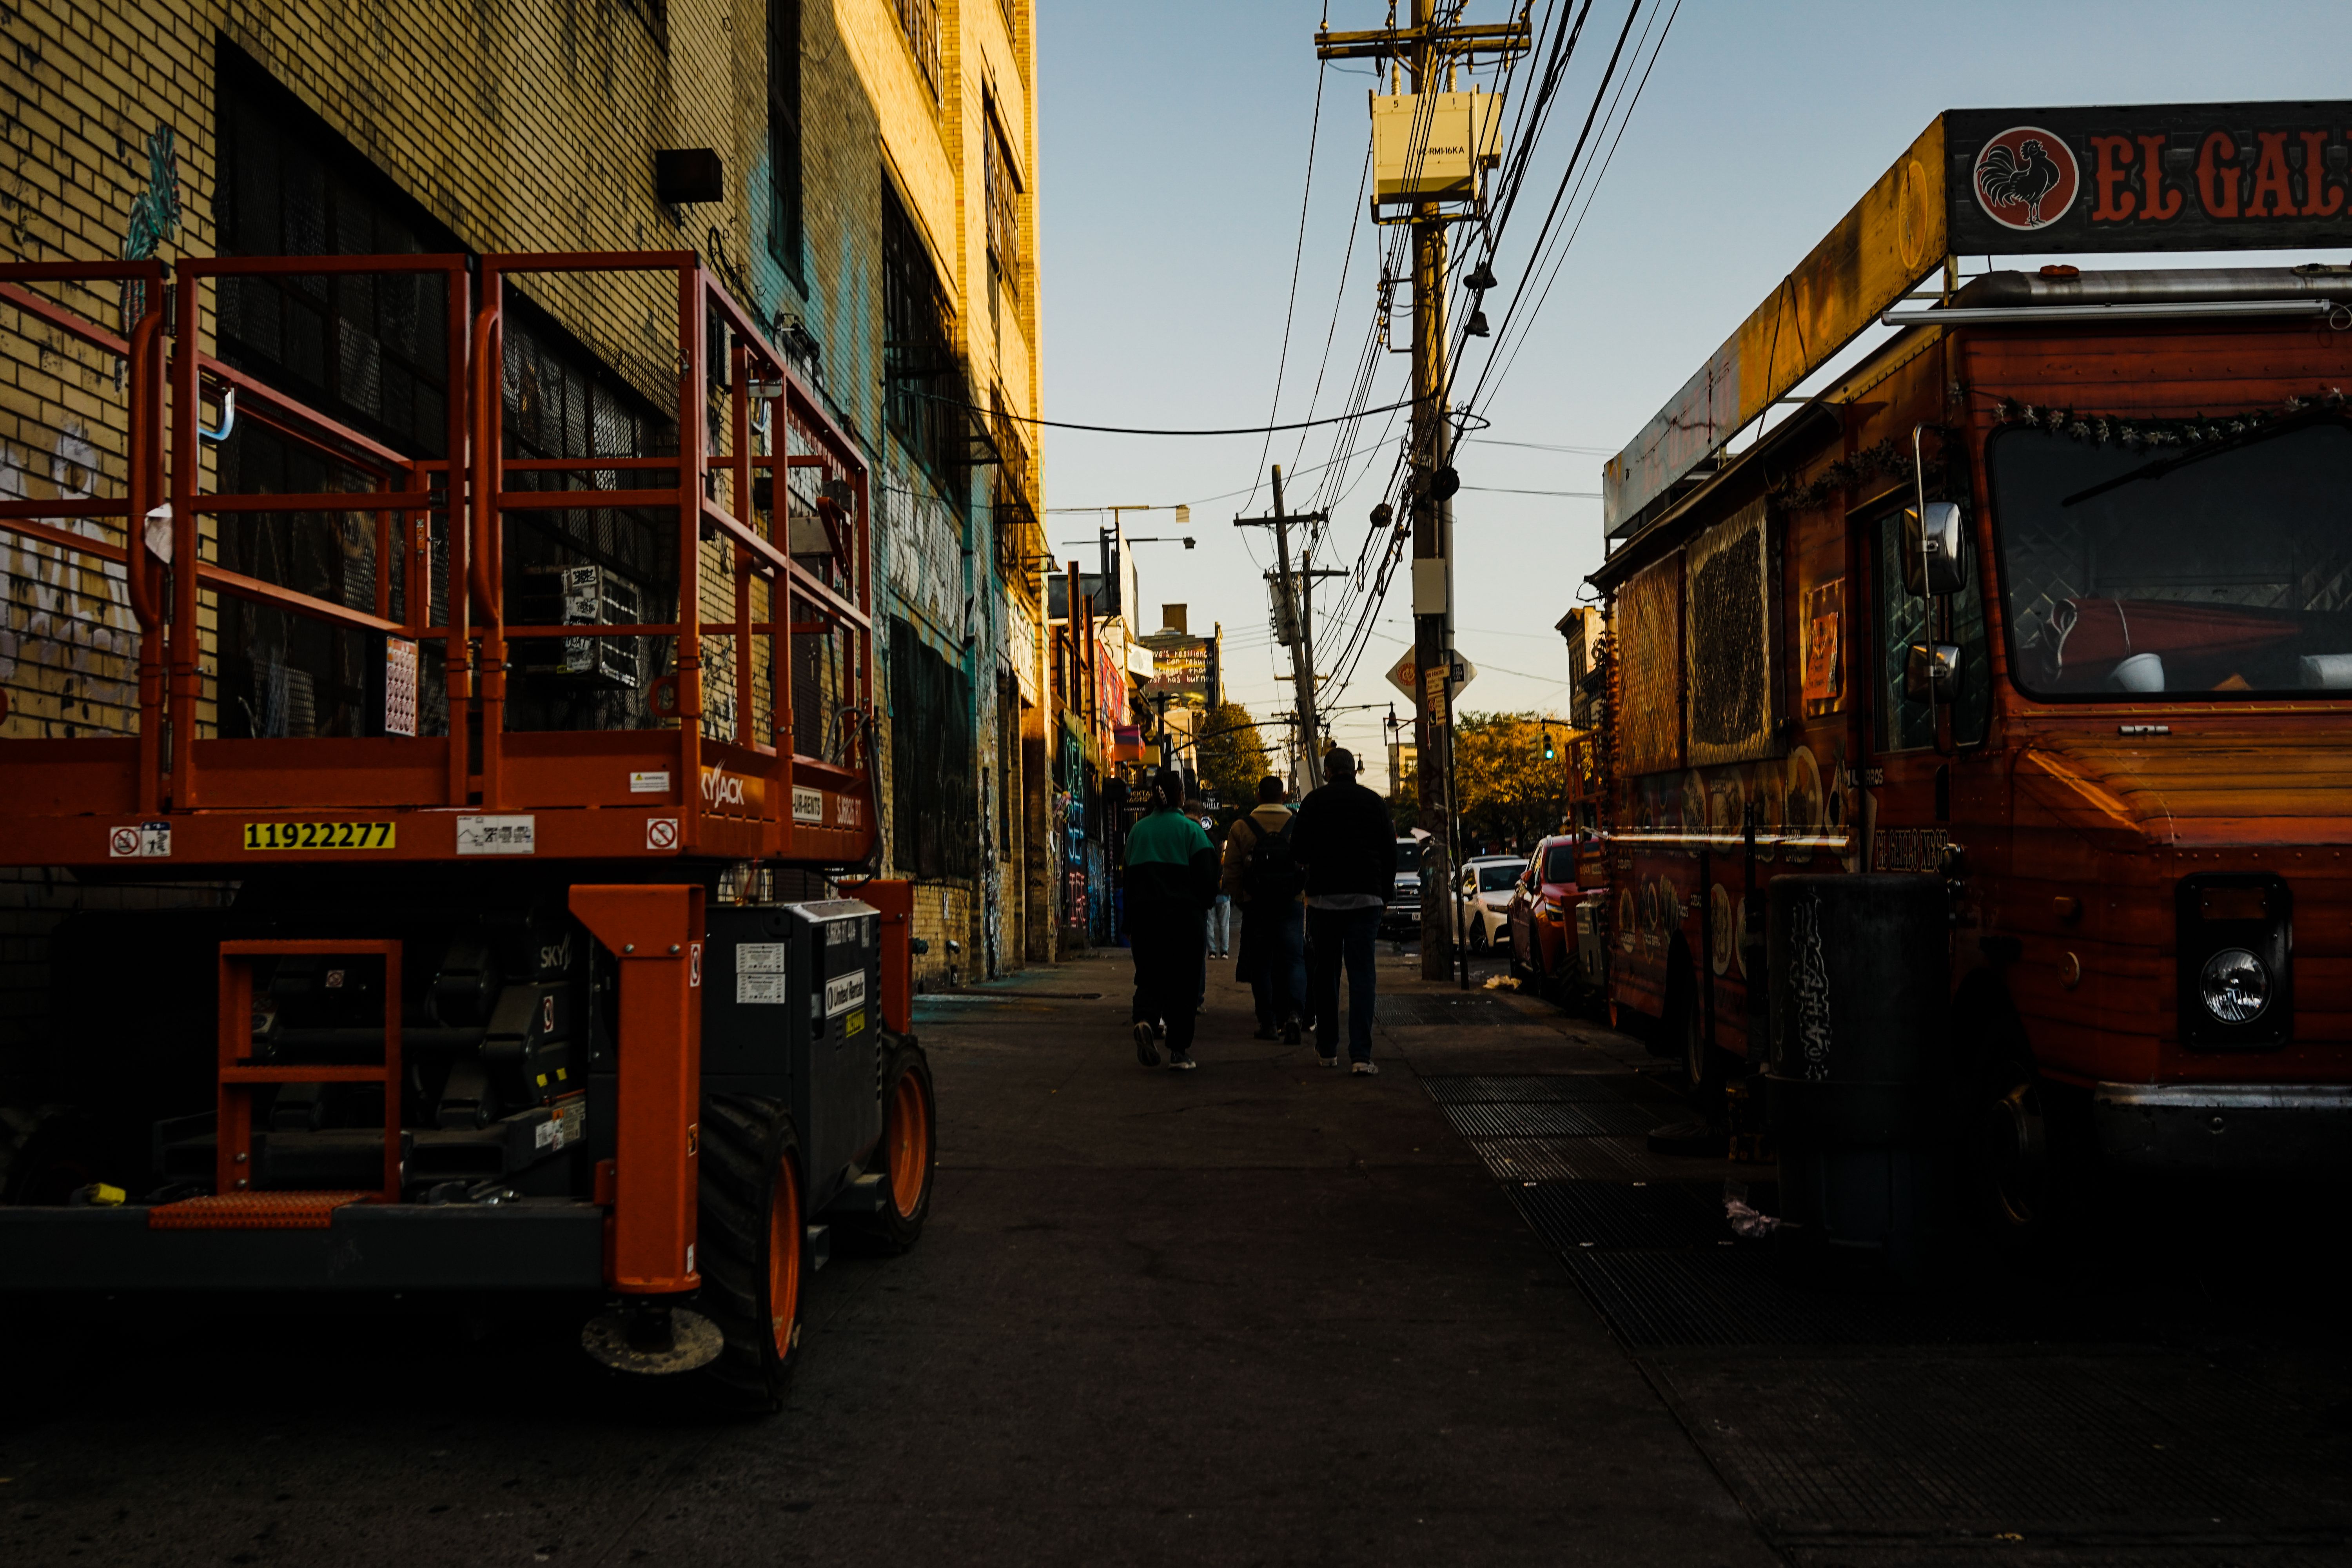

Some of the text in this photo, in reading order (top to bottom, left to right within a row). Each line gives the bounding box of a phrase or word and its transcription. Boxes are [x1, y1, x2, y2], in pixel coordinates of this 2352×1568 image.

[2090, 130, 2352, 222] EL GAL
[1174, 650, 1213, 659] resilience
[1167, 675, 1181, 683] has
[1187, 674, 1214, 684] burned
[247, 823, 391, 848] 11922277
[1876, 829, 1887, 871] EL
[1889, 828, 1919, 871] GALLO
[833, 981, 850, 1007] United
